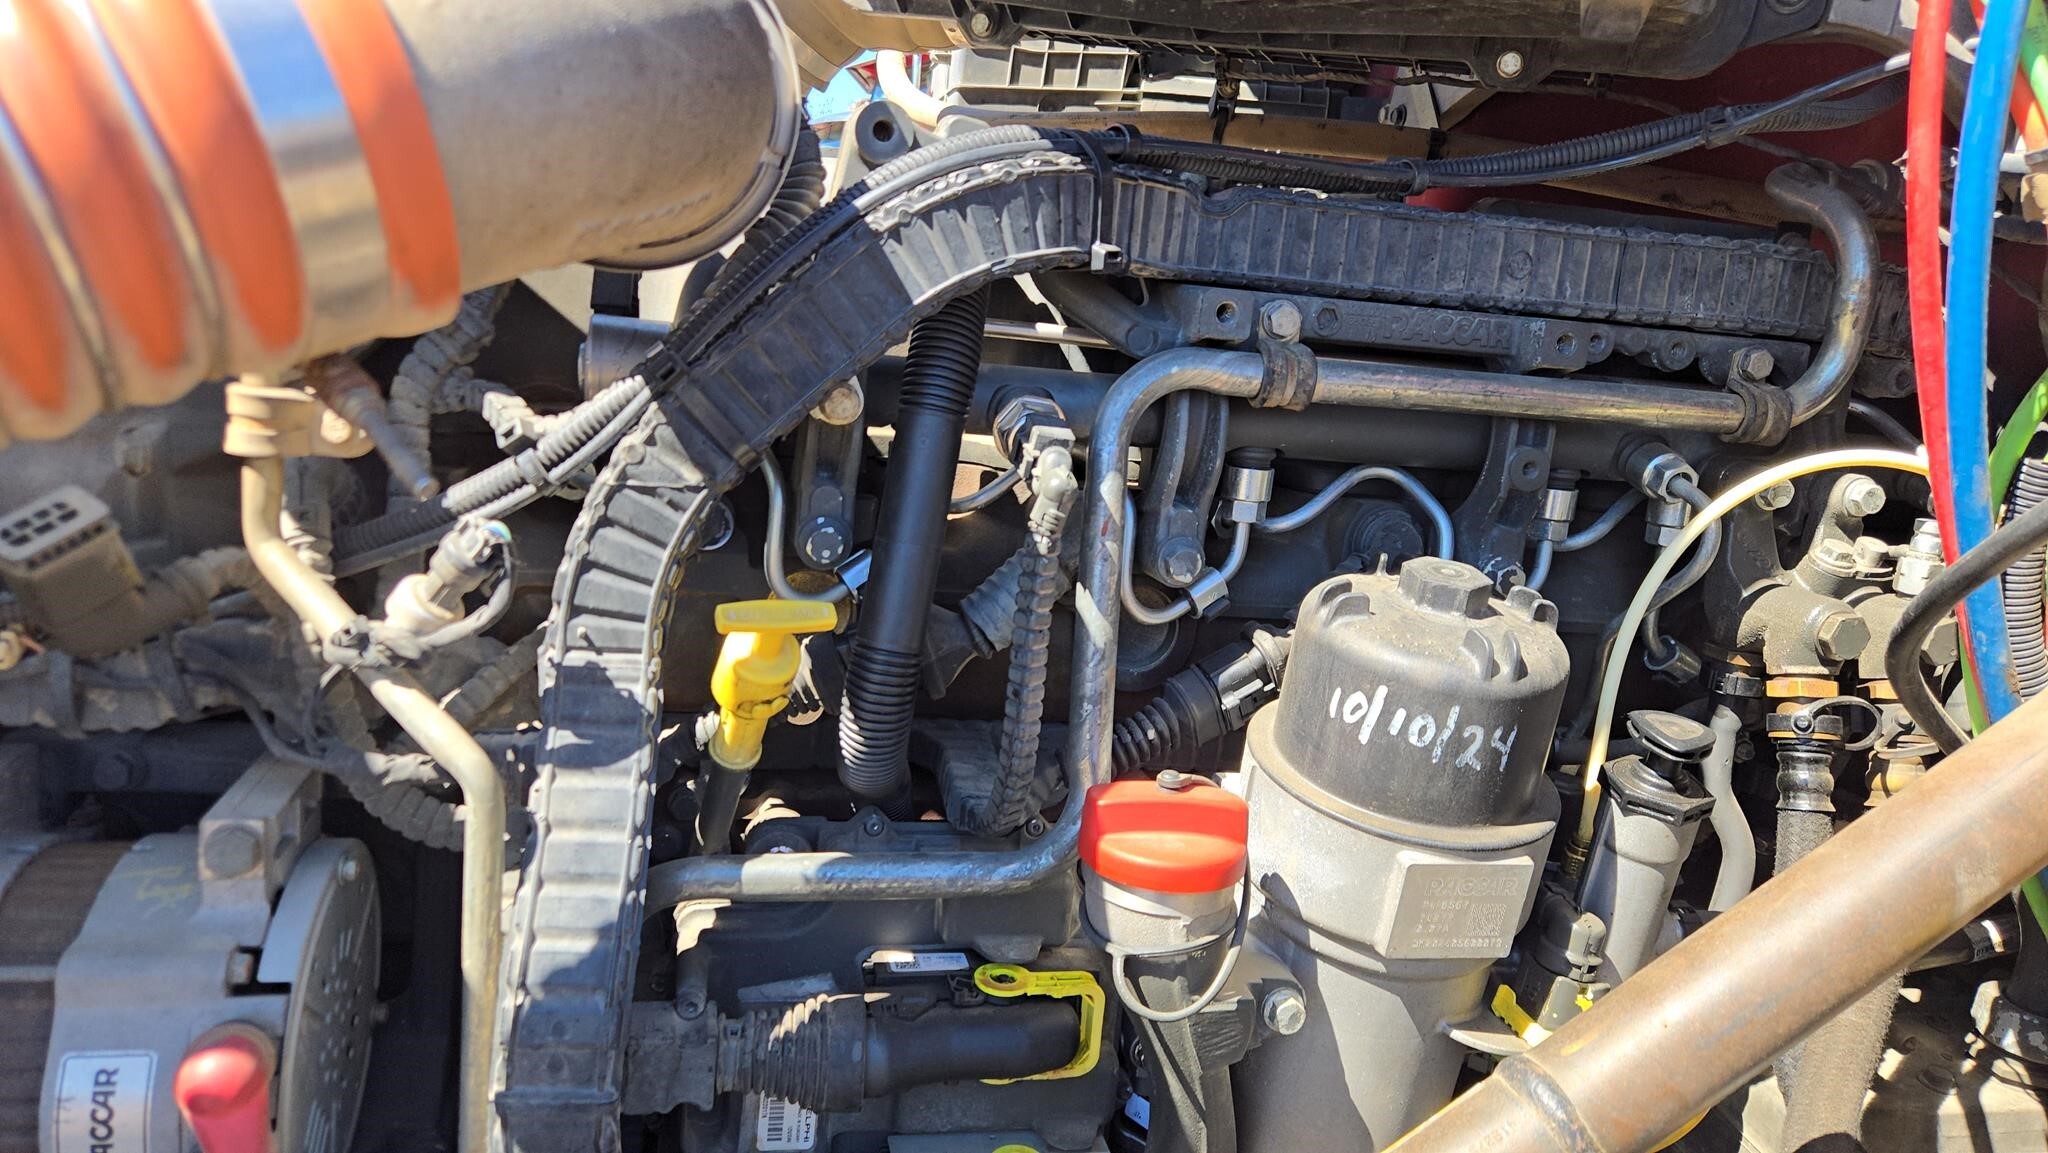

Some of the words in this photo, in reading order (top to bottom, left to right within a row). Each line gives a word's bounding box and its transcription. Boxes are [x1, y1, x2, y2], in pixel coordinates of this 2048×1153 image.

[1382, 310, 1513, 349] PACCAR
[1329, 685, 1518, 772] 10/10/24
[1423, 877, 1519, 897] PACCAR
[90, 1068, 120, 1153] ACCAR
